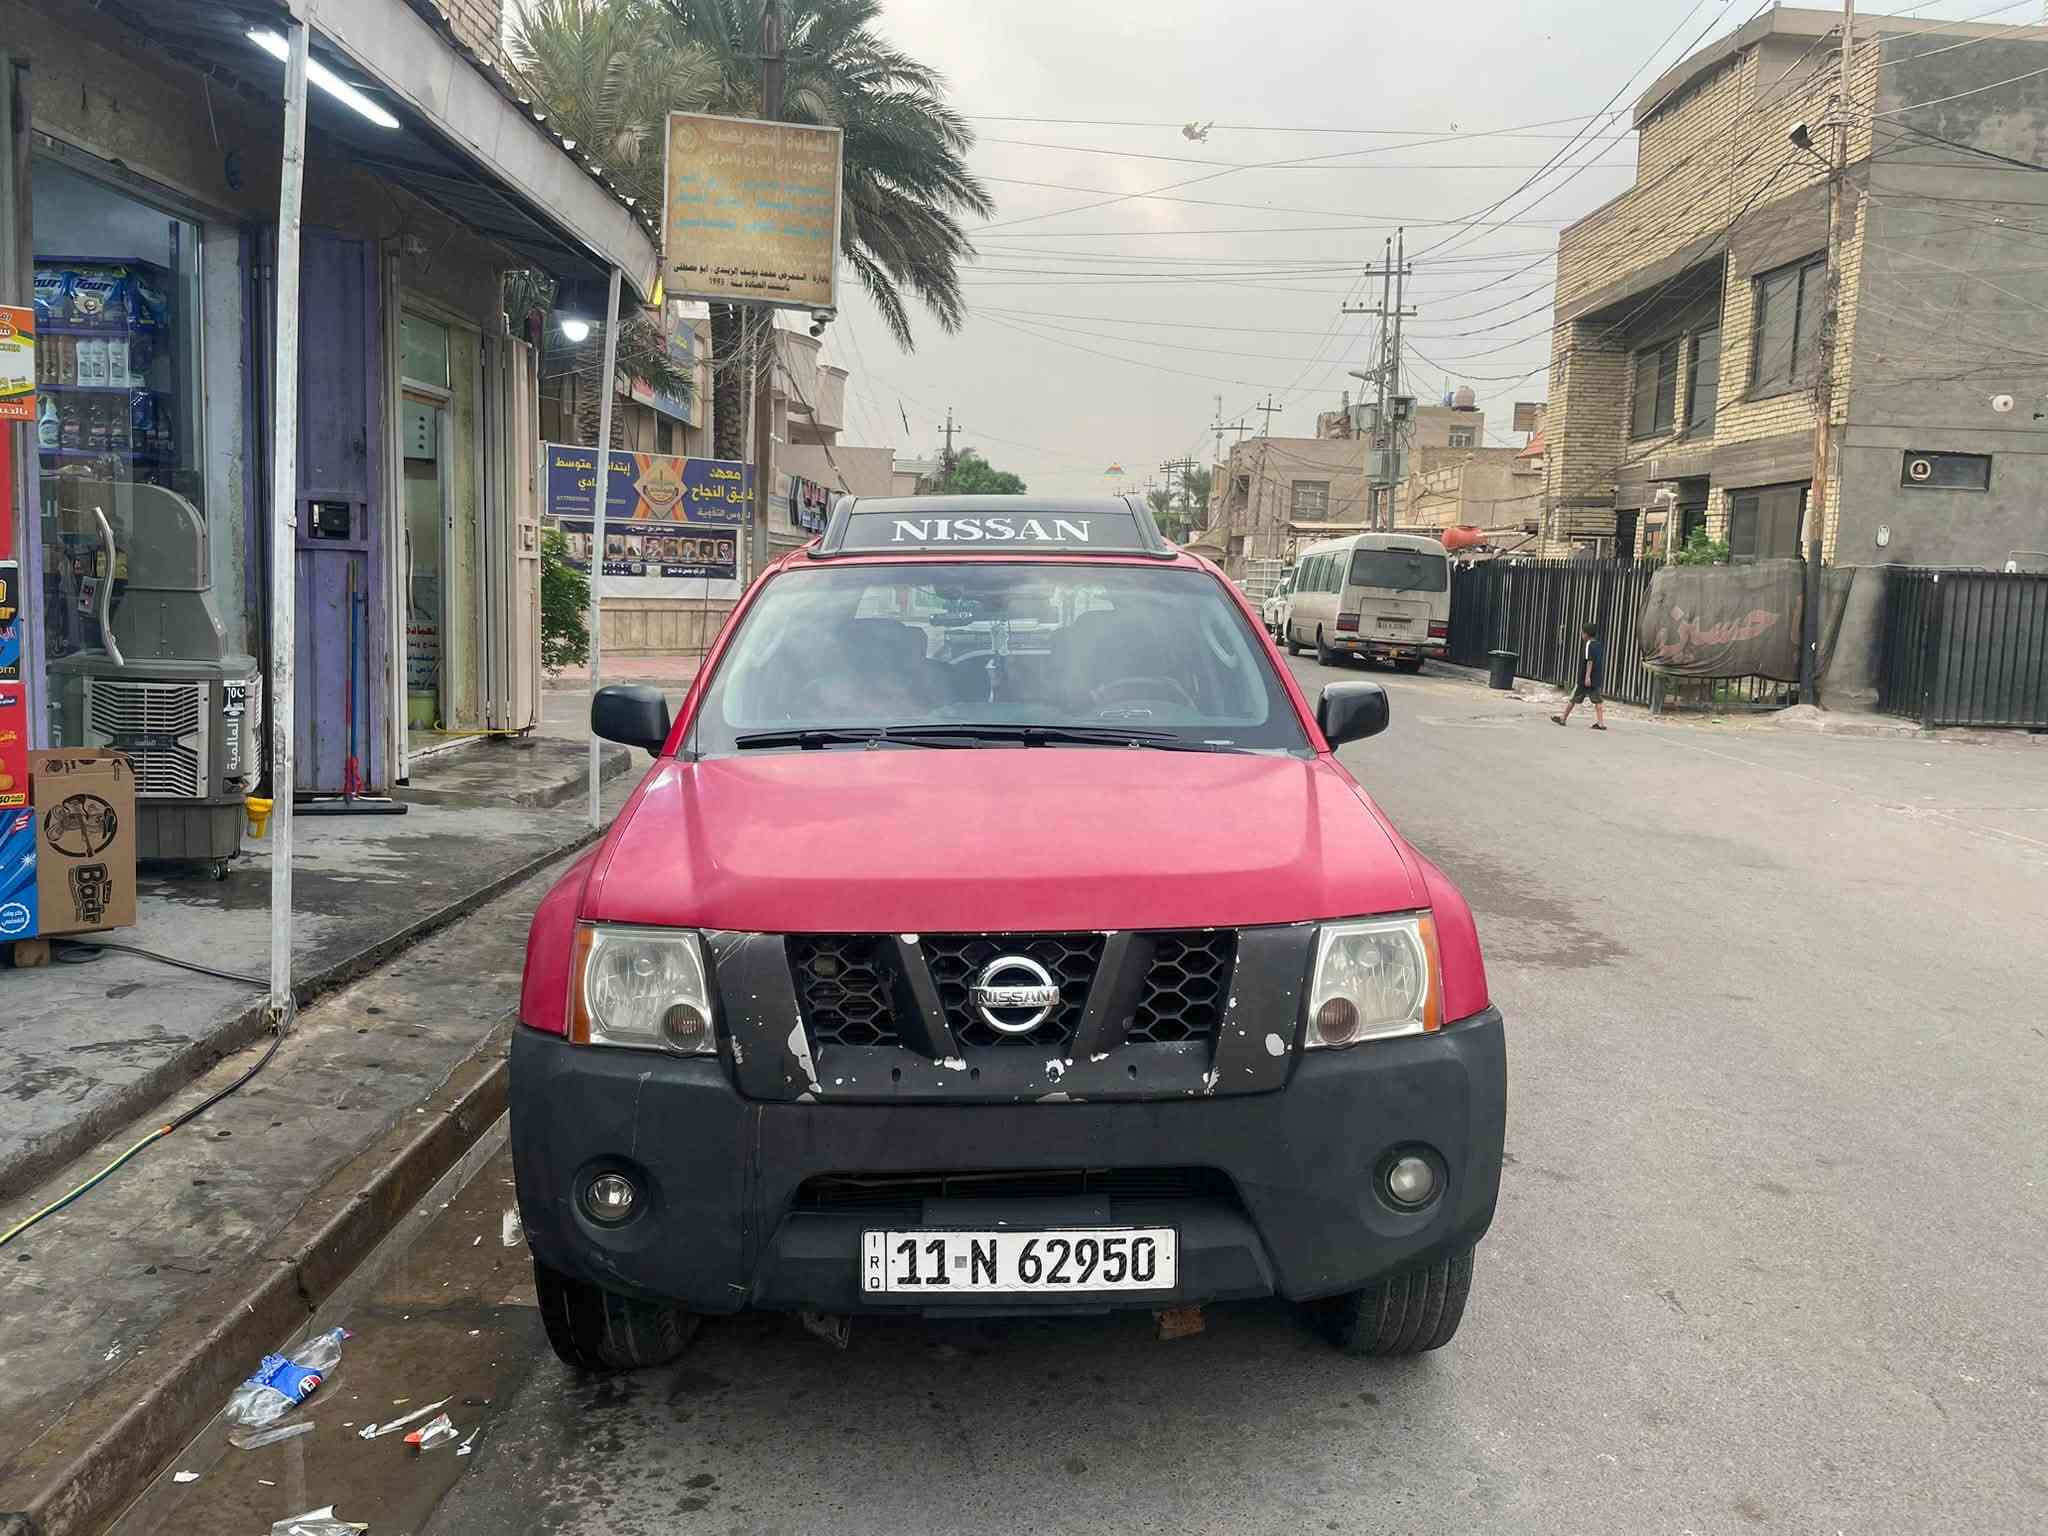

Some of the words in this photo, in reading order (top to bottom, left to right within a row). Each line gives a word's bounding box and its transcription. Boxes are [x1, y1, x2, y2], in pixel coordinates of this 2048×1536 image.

[709, 466, 742, 481] معهد
[691, 483, 725, 502] النجاح
[891, 518, 1092, 543] NISSAN
[976, 989, 1053, 1004] NISSAN
[971, 1239, 997, 1284] N
[1018, 1237, 1156, 1285] 62950
